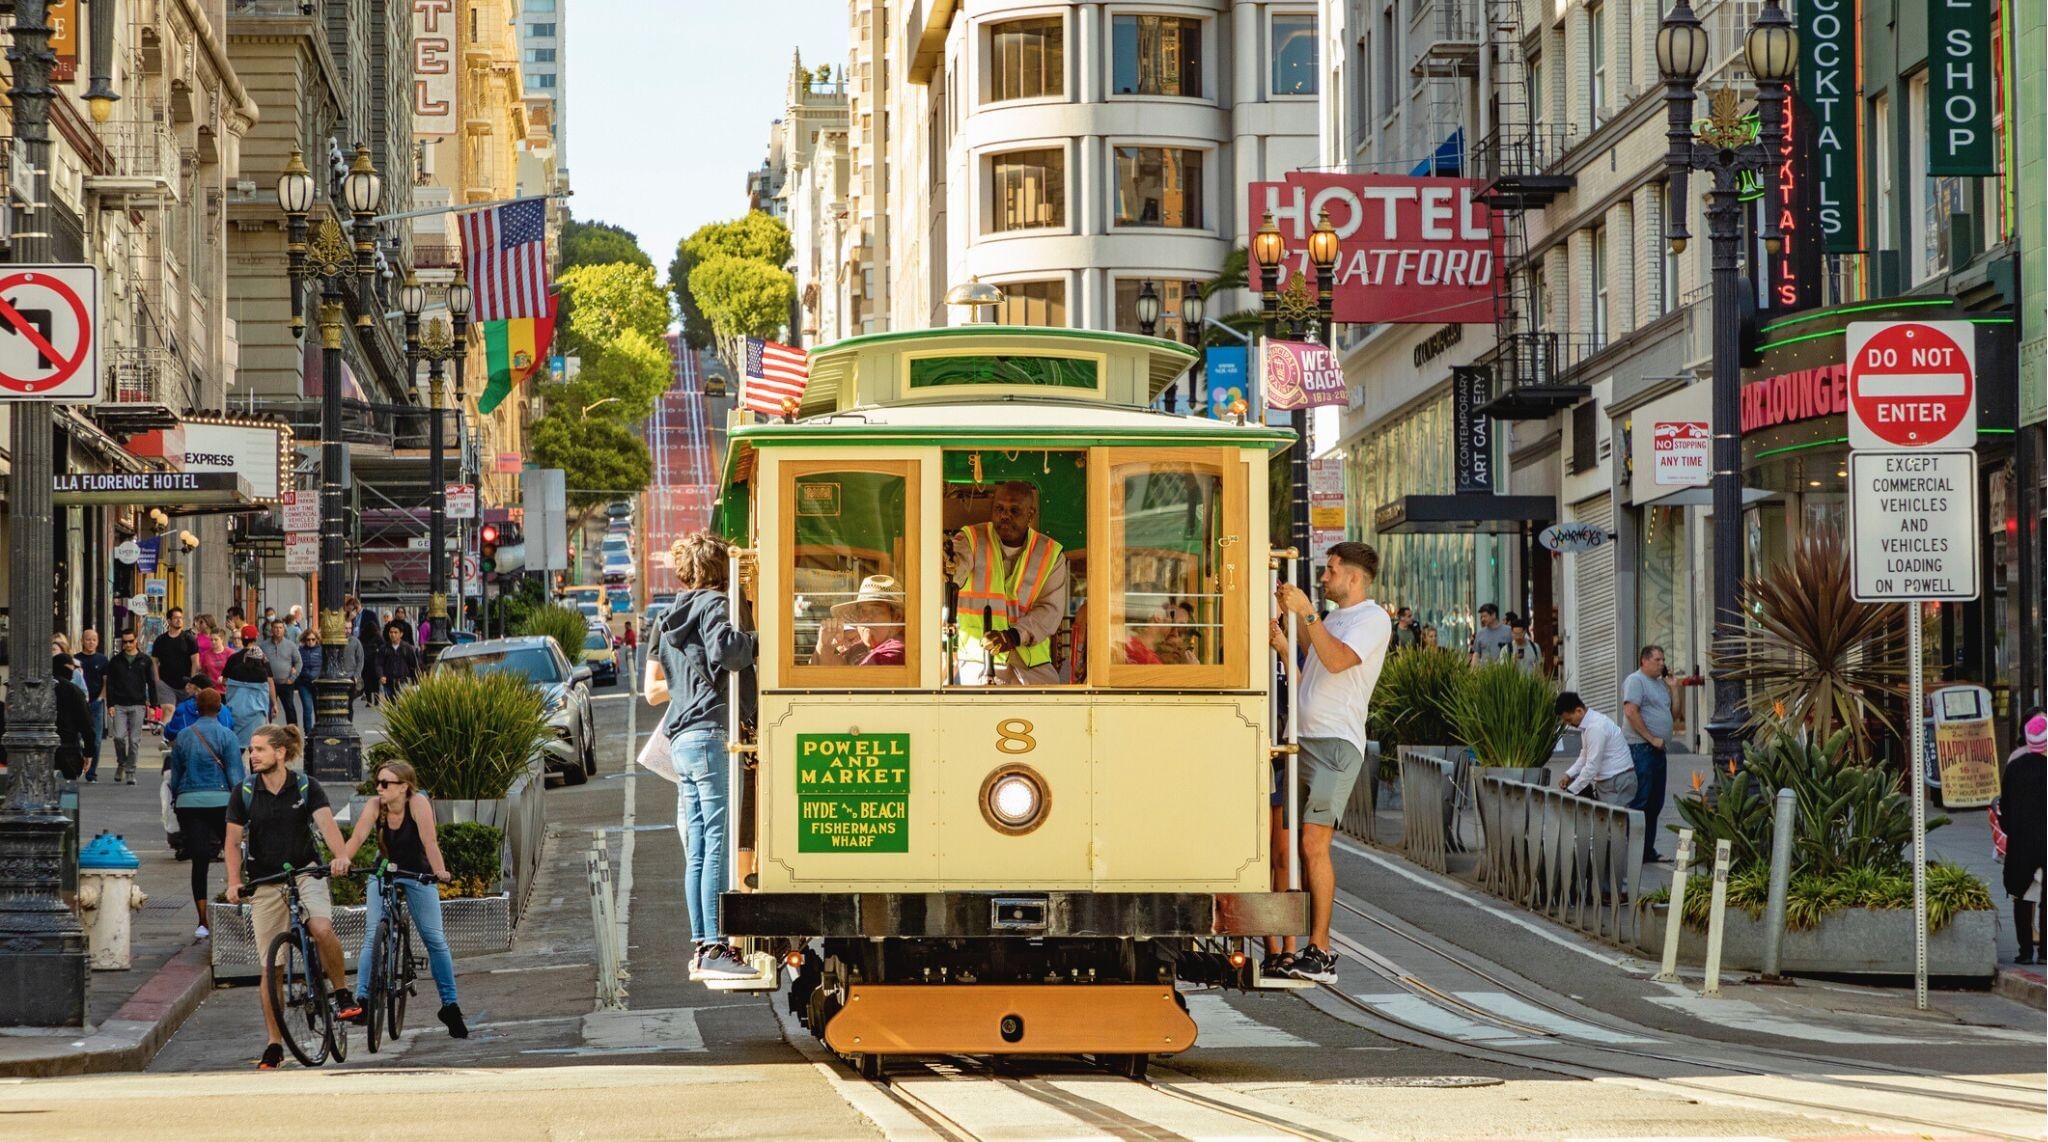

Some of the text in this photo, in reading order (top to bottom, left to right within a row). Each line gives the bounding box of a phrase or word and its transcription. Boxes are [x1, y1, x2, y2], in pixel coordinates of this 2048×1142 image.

[1945, 29, 1977, 156] SHOP
[1266, 186, 1489, 240] HOTEL
[1868, 347, 1954, 368] DO NOT
[1303, 369, 1346, 390] BACK
[1766, 363, 1847, 424] LOUNGE
[1459, 374, 1469, 467] CONTEMPORARY
[1877, 403, 1946, 423] ENTER
[1473, 374, 1487, 484] ART GALERY
[1656, 440, 1706, 449] NO STOPPING
[184, 452, 234, 467] EXPRESS
[1660, 456, 1702, 466] ANY TIME
[1886, 457, 1939, 472] EXCEPT
[82, 474, 149, 489] FLORENCE
[153, 474, 199, 489] HOTEL
[1872, 478, 1954, 492] COMMERCIAL
[284, 493, 294, 503] NO
[1881, 498, 1947, 512] VEHICLES
[1900, 518, 1928, 532] AND
[1881, 538, 1948, 552] VEHICLES
[1887, 558, 1942, 572] LOADING
[1875, 578, 1955, 593] ON POWELL
[995, 718, 1036, 754] 8
[803, 740, 905, 756] POWELL
[1939, 737, 1996, 771] HAPPY HOUR
[830, 756, 879, 767] AND
[801, 769, 906, 783] MARKET
[803, 801, 905, 819] HYDE AND BEACH
[811, 822, 896, 834] FISHERMANS
[831, 835, 876, 847] WHARF
